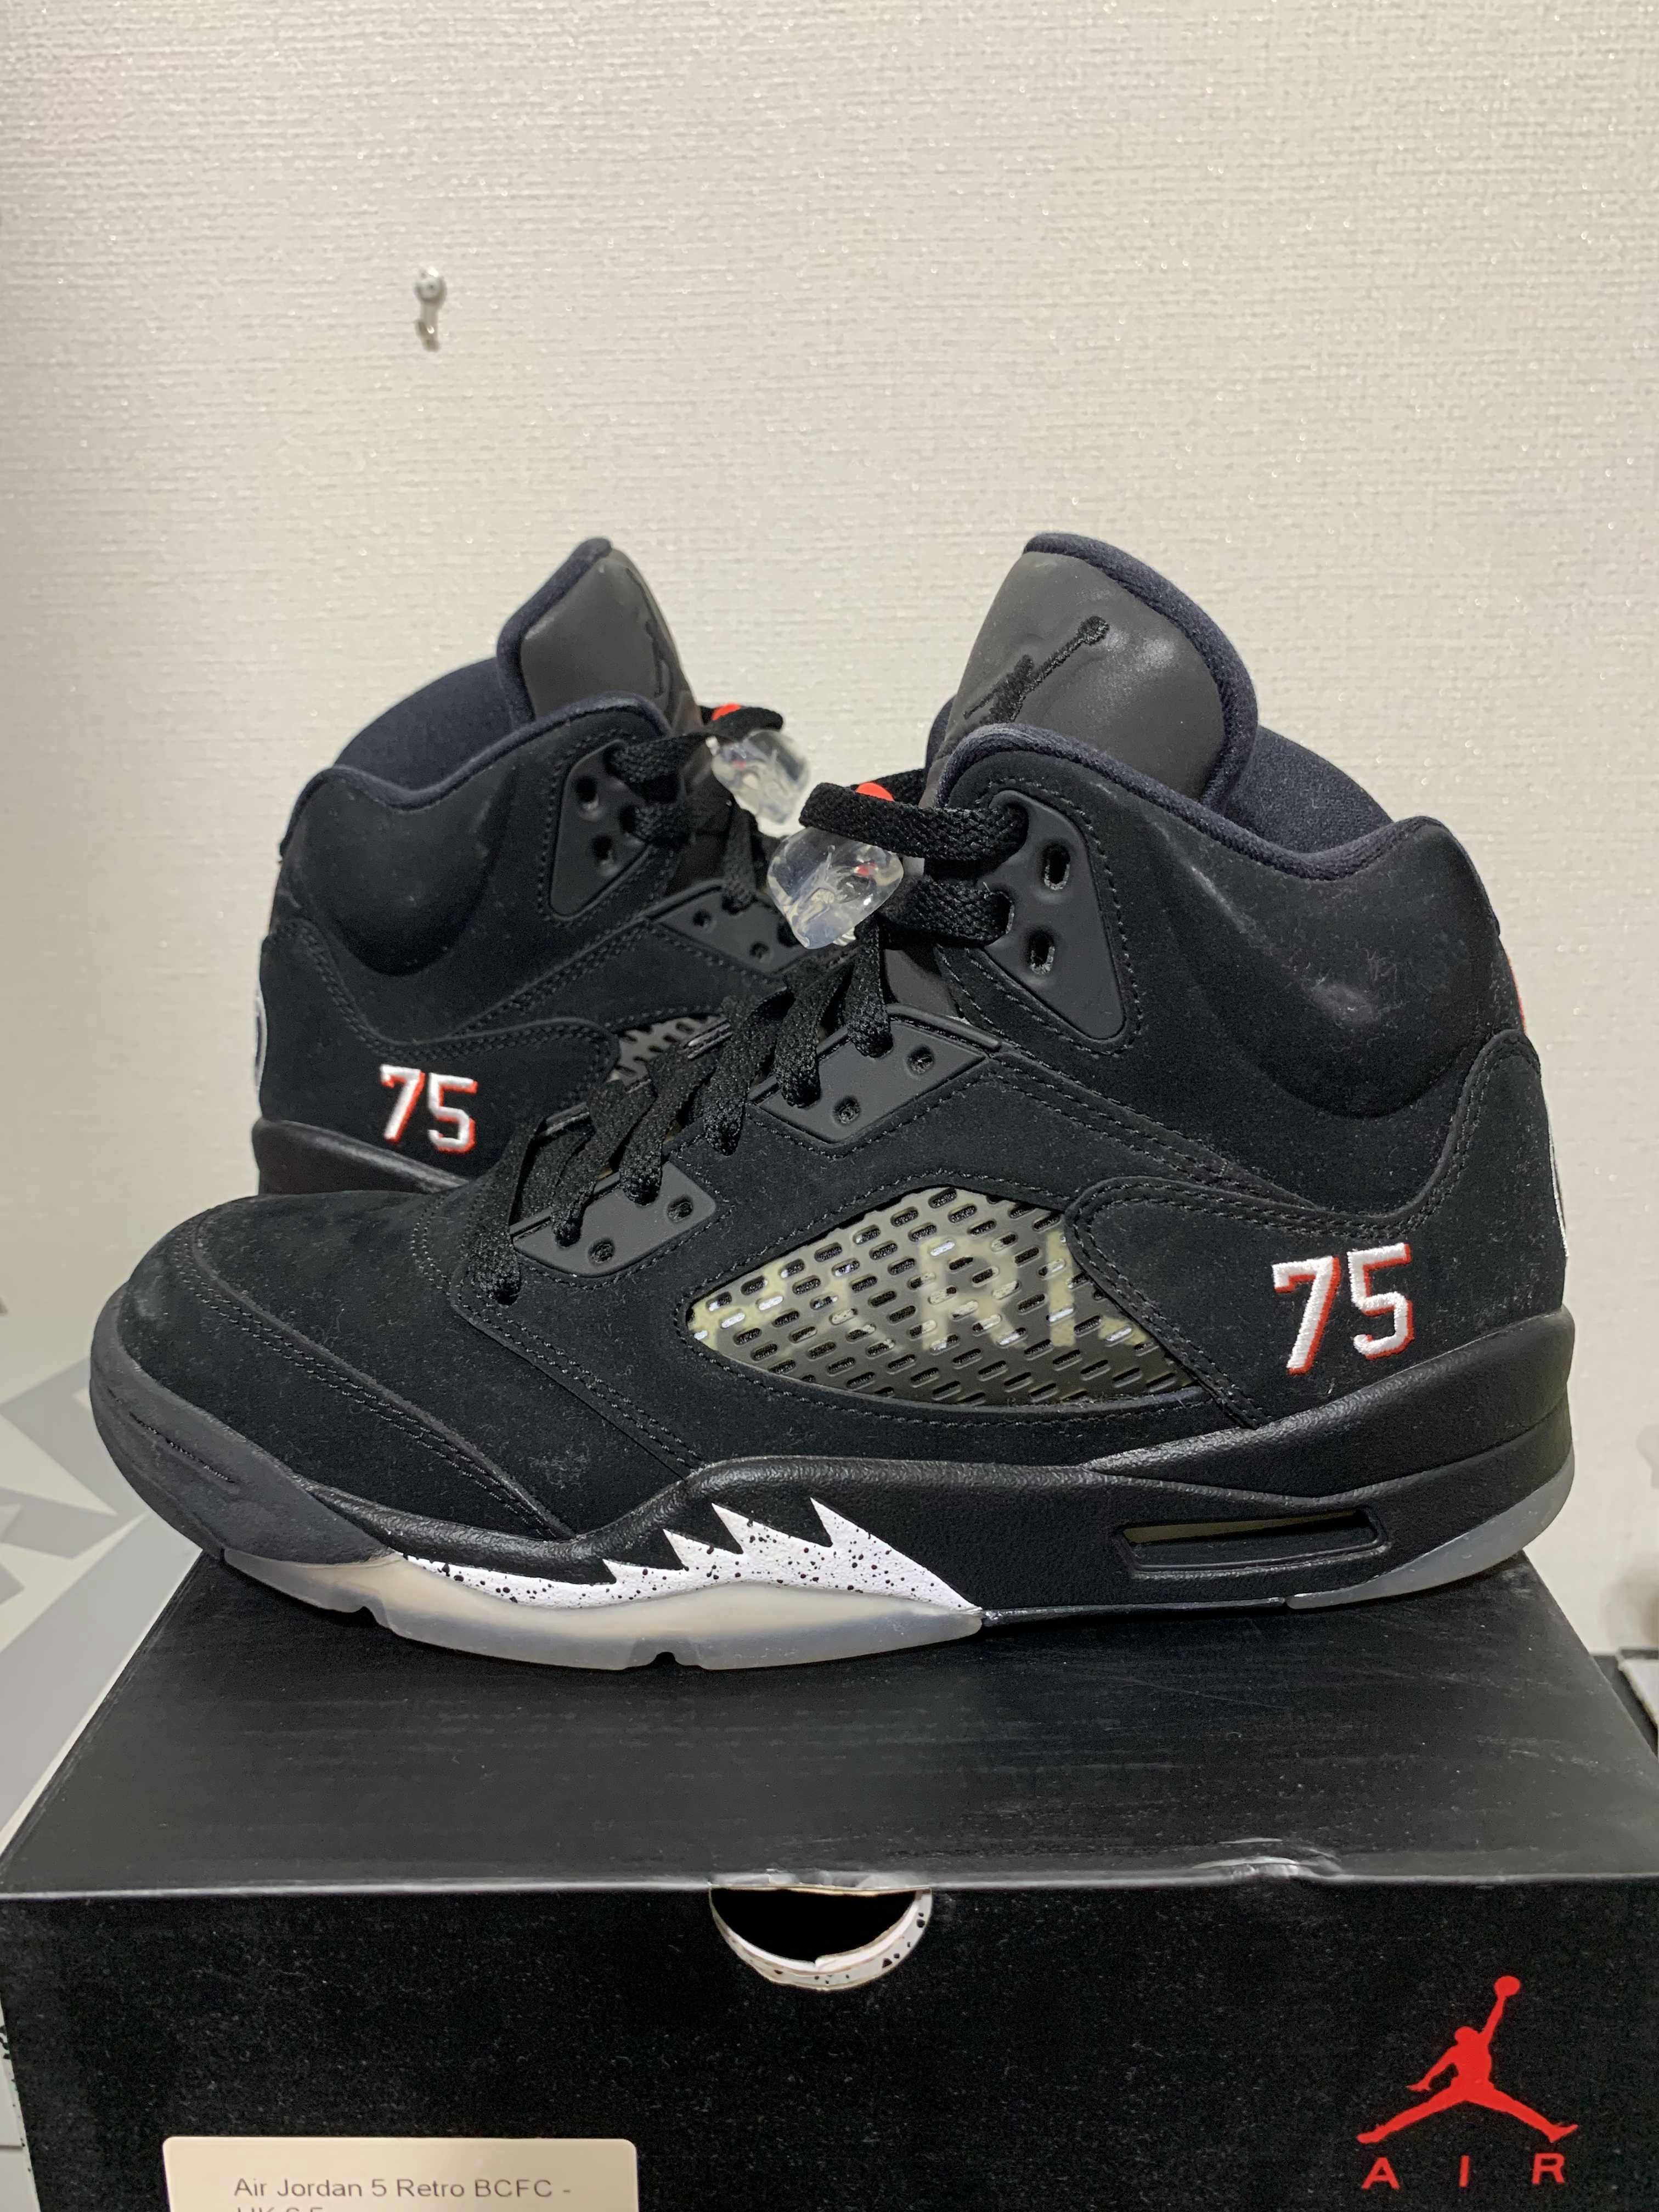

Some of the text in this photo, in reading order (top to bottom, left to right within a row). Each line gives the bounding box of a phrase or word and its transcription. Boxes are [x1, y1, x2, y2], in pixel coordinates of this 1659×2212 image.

[380, 1064, 478, 1153] 75
[1272, 1242, 1414, 1375] 75
[234, 2177, 266, 2196] Air
[277, 2179, 363, 2197] Jordan
[371, 2179, 387, 2197] 5
[397, 2179, 464, 2197] Retro
[475, 2179, 552, 2197] BCFC
[1361, 2152, 1565, 2190] AIR
